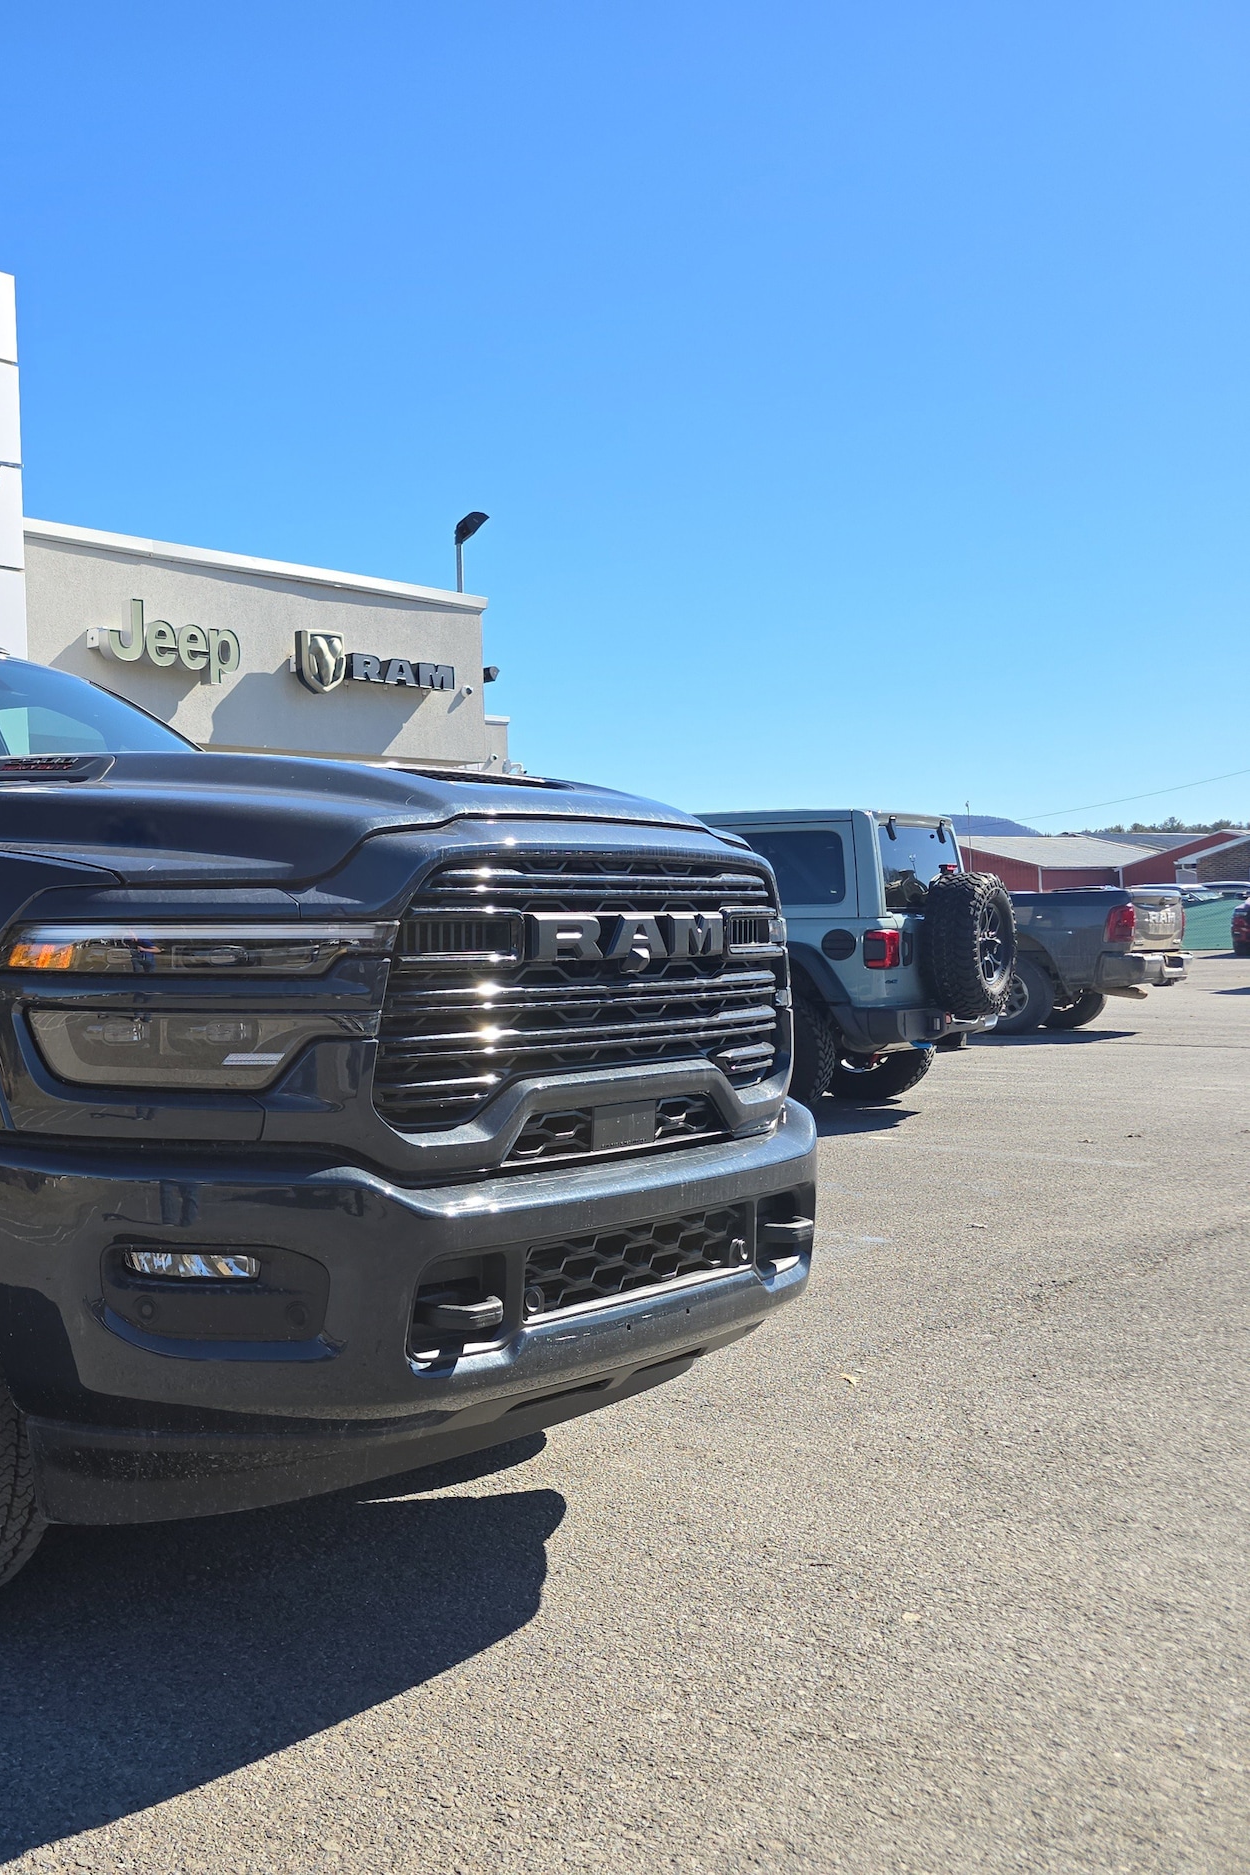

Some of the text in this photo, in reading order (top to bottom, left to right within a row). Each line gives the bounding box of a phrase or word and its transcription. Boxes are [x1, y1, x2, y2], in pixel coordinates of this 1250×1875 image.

[99, 598, 240, 685] Jeep
[351, 653, 455, 691] RAM
[535, 911, 724, 962] RAM
